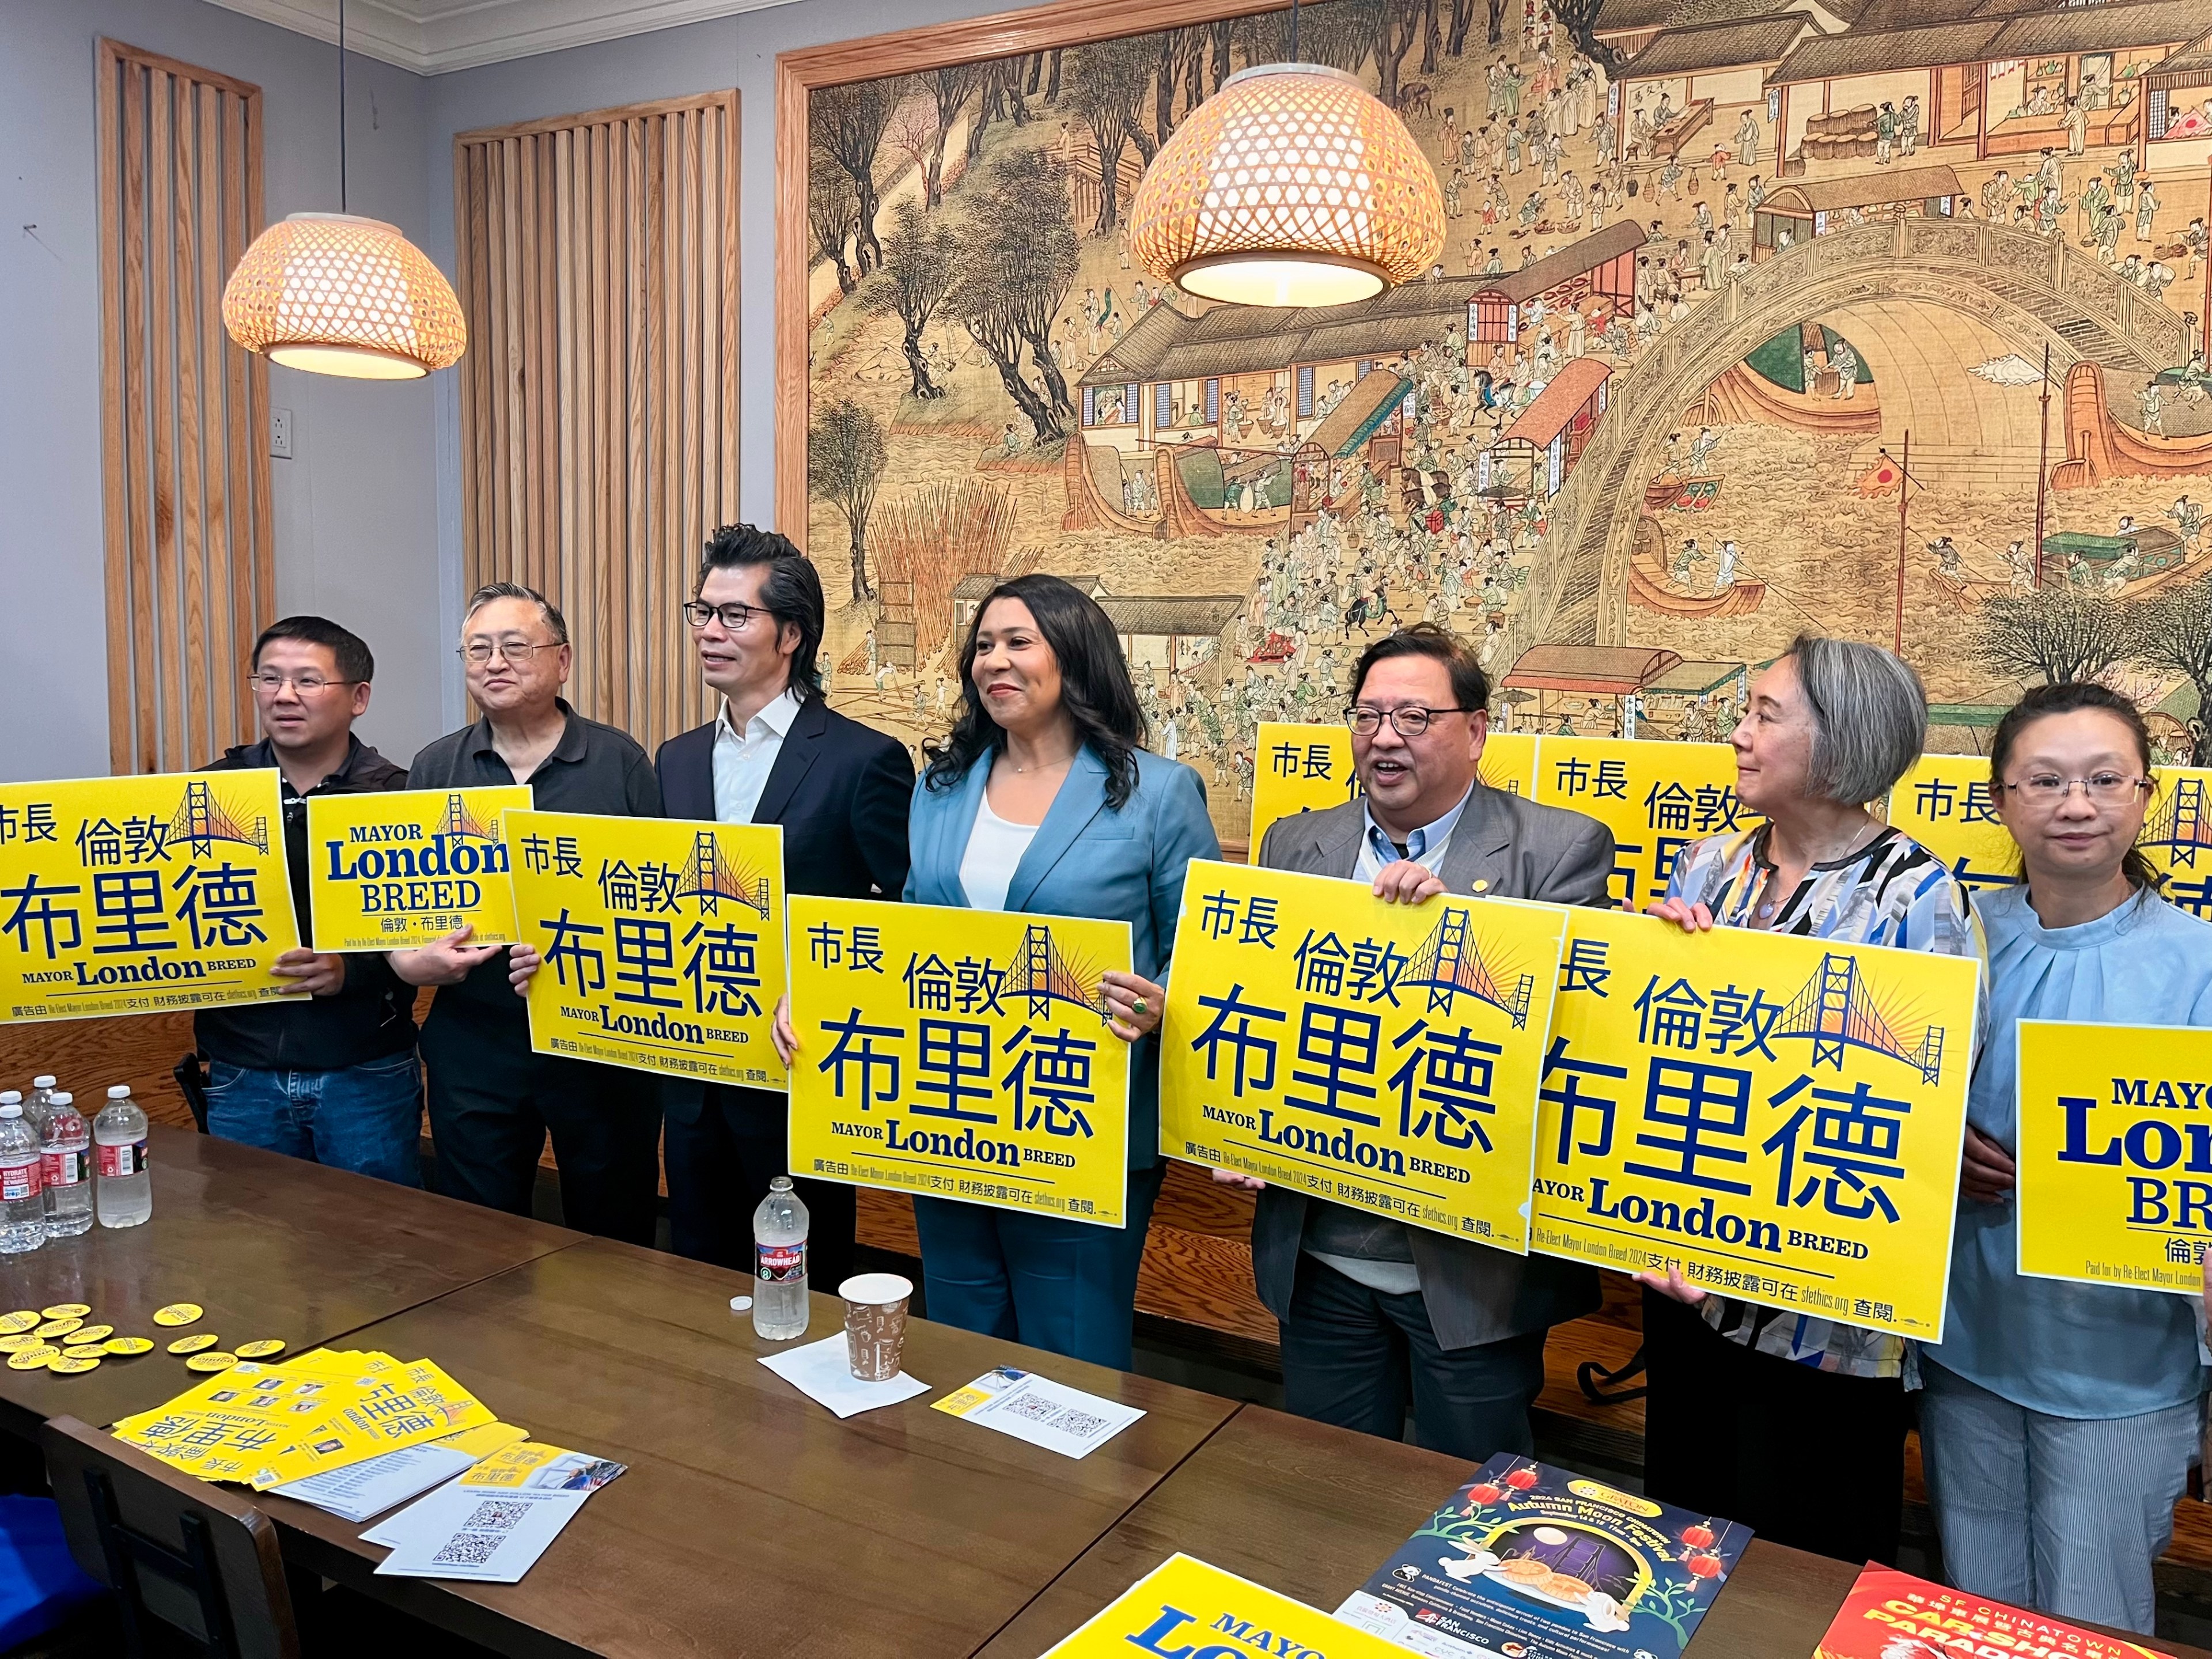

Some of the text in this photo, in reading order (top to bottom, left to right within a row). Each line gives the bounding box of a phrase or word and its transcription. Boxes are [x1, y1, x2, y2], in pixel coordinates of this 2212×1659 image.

[1272, 742, 1332, 781] 市長
[1556, 757, 1627, 800] 市長
[1644, 781, 1741, 833] 倫敦
[1914, 778, 2002, 825] 市長
[75, 815, 172, 866] 倫敦
[350, 824, 423, 842] MAYOR
[521, 833, 584, 878] 市長
[326, 834, 509, 880] London
[360, 880, 480, 912] BREED
[598, 859, 682, 914] 倫敦
[1, 863, 268, 959] 布里德
[1201, 889, 1279, 950] 市長
[540, 908, 762, 1017] 布里德
[808, 922, 884, 974] 市長
[1293, 928, 1408, 1009] 倫敦
[1559, 938, 1611, 998] 長
[22, 957, 256, 986] MAYOR London BREED
[903, 952, 1006, 1017] 倫敦
[560, 1005, 749, 1044] MAYOR London BREED
[1633, 974, 1784, 1062] 倫敦
[818, 1007, 1096, 1139] 布里德
[1191, 983, 1503, 1154] 布里德
[831, 1119, 1075, 1168] MAYOR London BREED
[1202, 1105, 1471, 1183] MAYOR London BREED
[1539, 1035, 1912, 1224] 布里德
[3, 1168, 28, 1176] HYDRATE
[1185, 1141, 1221, 1163] 廣告由
[1243, 1157, 1258, 1173] Mayor
[1259, 1161, 1277, 1177] London
[1278, 1166, 1292, 1181] Breed
[1338, 1183, 1421, 1218] 財務披露可在
[1532, 1177, 1869, 1260] AYOR London BREED
[760, 1255, 800, 1266] ARROWHEAD
[1537, 1228, 1561, 1247] Re-Elect
[1563, 1234, 1581, 1252] Mayor
[1584, 1238, 1606, 1256] London
[1609, 1244, 1627, 1261] Breed
[1687, 1261, 1798, 1302] 財務披露可在
[1801, 1289, 1849, 1317] sfethics.org
[2086, 1260, 2200, 1287] Paid for by Re-Elect Mayor London
[138, 1415, 276, 1452] 布里德
[206, 1412, 266, 1426] London
[343, 1408, 370, 1430] ondon
[200, 1457, 244, 1474] 市長
[1540, 1510, 1578, 1519] September
[1575, 1499, 1626, 1518] FRANCISCO
[1626, 1516, 1671, 1544] CHINATOWN
[1601, 1491, 1649, 1513] GRATON
[1508, 1501, 1677, 1562] Autumn Moon Festival
[1422, 1574, 1452, 1588] PANDAFEST
[1516, 1609, 1533, 1618] arrival
[1884, 1600, 1974, 1637] CAR
[1435, 1620, 1490, 1645] FRANCISCO
[1440, 1616, 1460, 1628] SAN
[1548, 1627, 1570, 1638] cultural
[1570, 1635, 1610, 1652] performances!
[1863, 1609, 2028, 1659] PARAD
[1940, 1594, 2122, 1656] SF CHINATOWN
